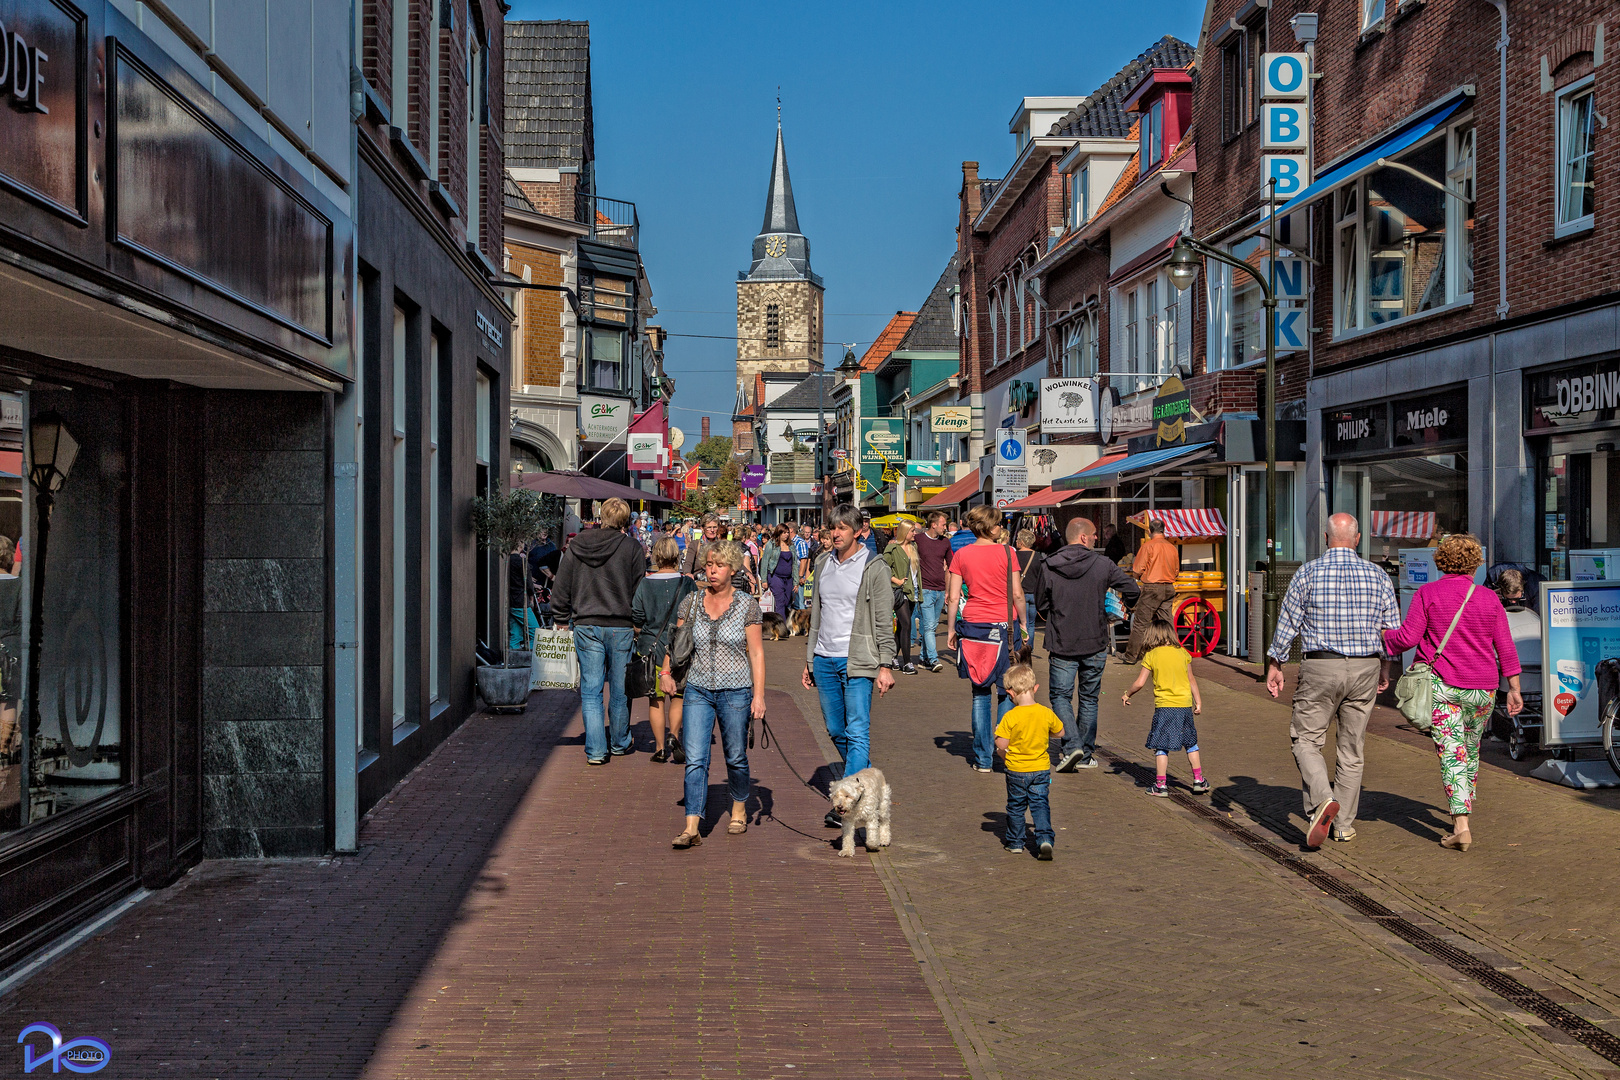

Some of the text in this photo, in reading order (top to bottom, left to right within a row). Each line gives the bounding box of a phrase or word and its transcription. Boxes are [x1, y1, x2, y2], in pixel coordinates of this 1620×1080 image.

[1267, 55, 1303, 347] OBBINK
[1045, 380, 1093, 393] WOLWINKEL
[1557, 370, 1620, 415] OBBINK
[590, 403, 620, 415] G&W
[934, 416, 968, 428] Ziengs
[1077, 417, 1098, 425] Schp
[1407, 406, 1448, 431] Miele
[587, 423, 618, 432] ACHTERHOEKS
[1337, 418, 1369, 441] PHILIPS
[1553, 594, 1590, 605] Nu geen
[1552, 604, 1620, 616] eenmalige kost
[536, 634, 574, 645] Laat fashi
[535, 644, 556, 652] geen
[535, 651, 567, 659] worden
[1556, 697, 1574, 705] Bestel
